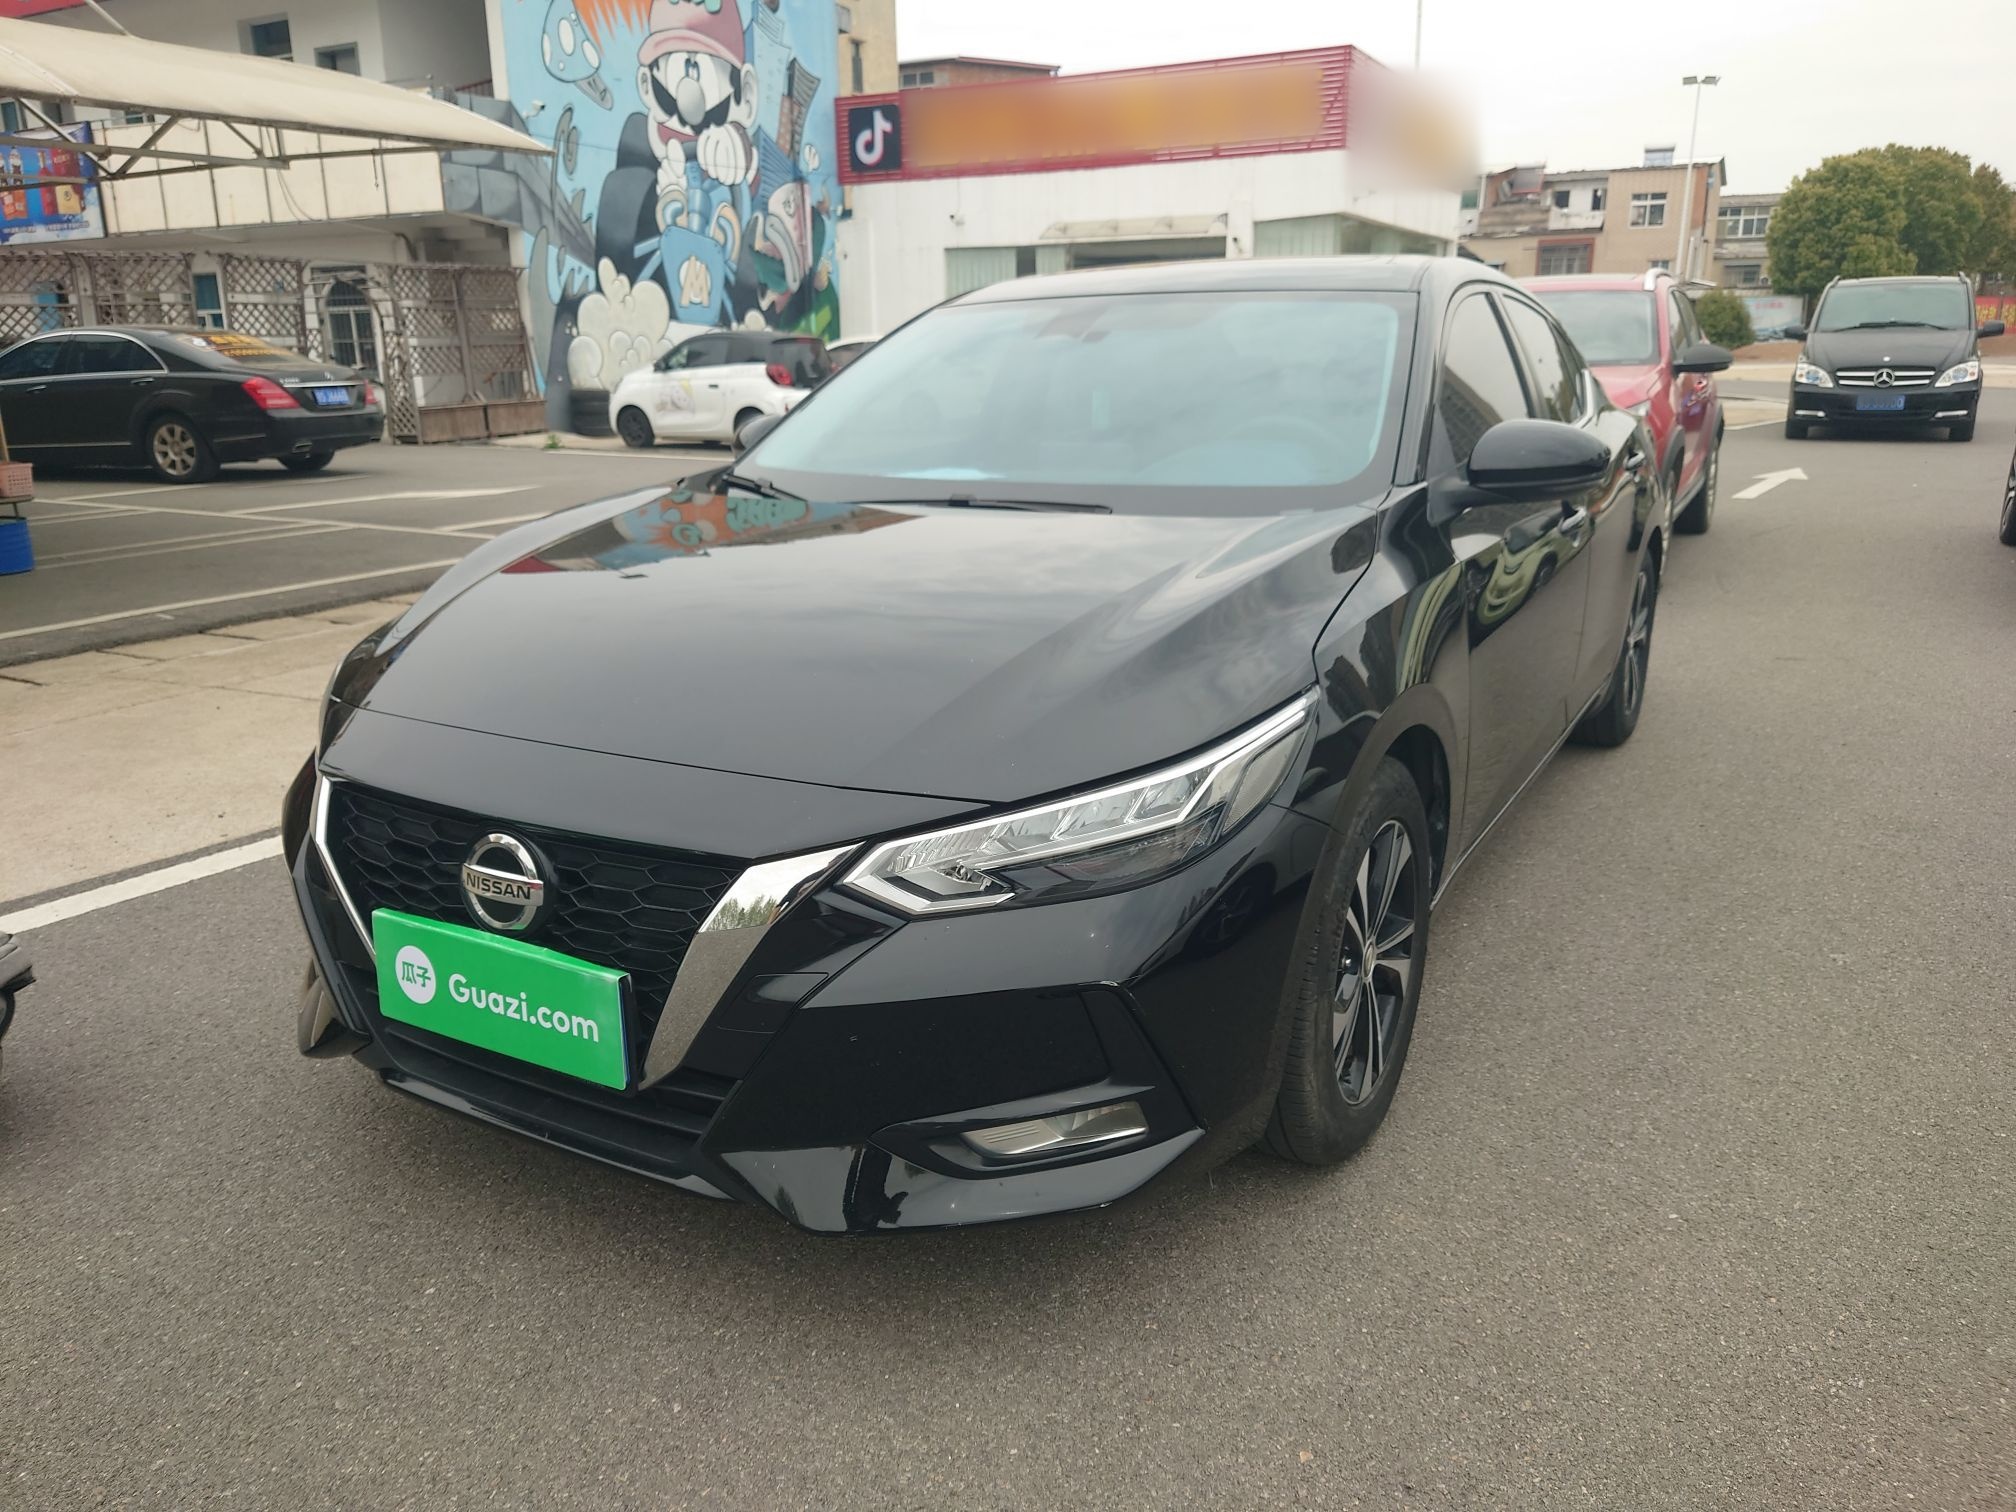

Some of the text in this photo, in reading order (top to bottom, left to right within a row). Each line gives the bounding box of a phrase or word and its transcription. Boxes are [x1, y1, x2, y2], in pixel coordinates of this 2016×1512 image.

[680, 255, 709, 307] M
[465, 872, 532, 900] NISSAN
[401, 960, 432, 988] 瓜子
[448, 972, 600, 1043] Guazi.com
